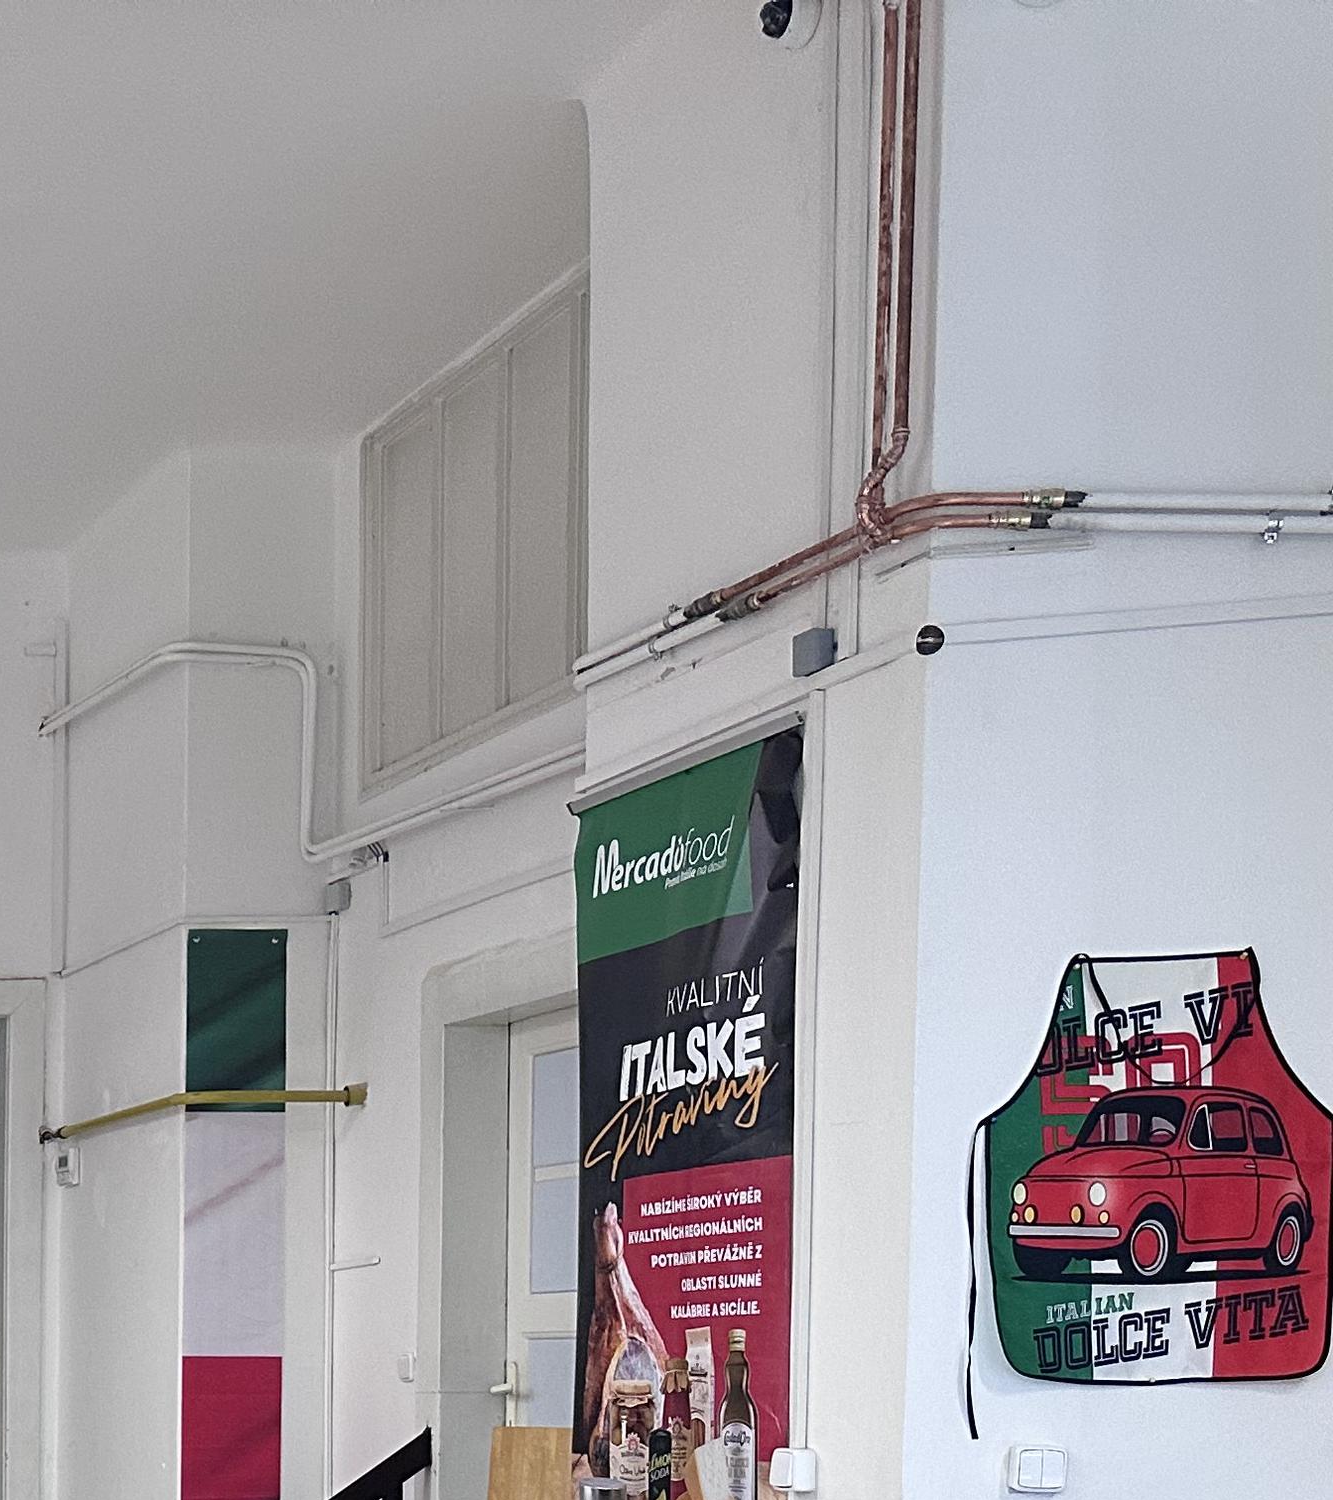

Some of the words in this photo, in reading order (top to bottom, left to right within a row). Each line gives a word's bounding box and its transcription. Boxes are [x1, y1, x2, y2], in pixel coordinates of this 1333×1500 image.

[666, 957, 764, 1016] KVALITNÍ
[619, 994, 765, 1102] ITALSKÉ
[584, 1061, 779, 1182] Potraviny
[641, 1195, 687, 1217] NABÍZÍME
[724, 1188, 762, 1206] VÝBĚR
[628, 1225, 685, 1245] KVALITNÍCH
[685, 1217, 763, 1239] REGIONÁLNÍCH
[698, 1246, 752, 1265] PŘEVÁŽNĚ
[755, 1247, 763, 1259] Z
[681, 1277, 718, 1292] OBLASTI
[719, 1271, 762, 1289] SLUNNÉ
[671, 1302, 711, 1319] KALÁBRIE
[712, 1303, 720, 1315] A
[1045, 1292, 1135, 1324] ITALIAN
[1033, 1307, 1170, 1373] DOLCE
[1185, 1284, 1309, 1349] VITA
